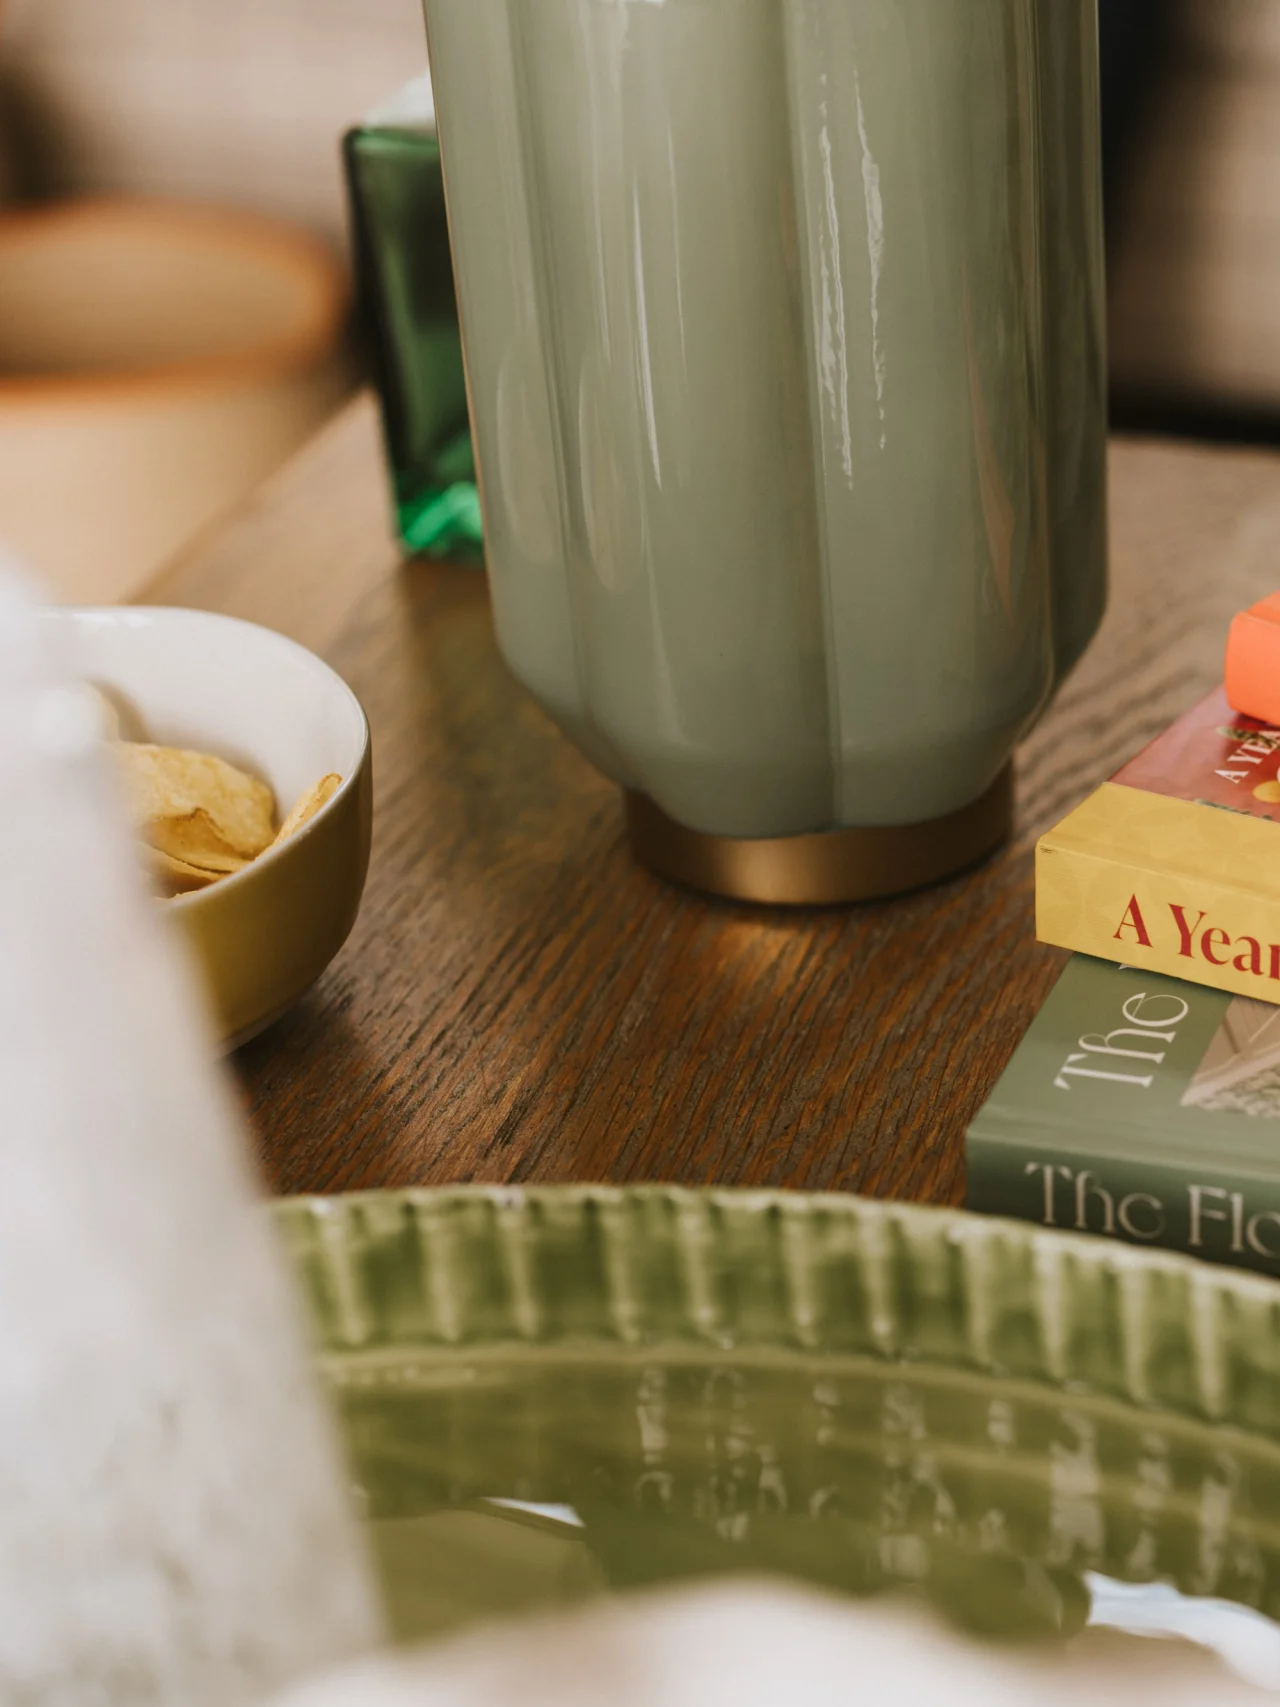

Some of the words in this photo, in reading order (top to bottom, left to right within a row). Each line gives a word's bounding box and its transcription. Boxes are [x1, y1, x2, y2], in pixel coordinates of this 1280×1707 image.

[1214, 769, 1250, 785] A
[1113, 893, 1153, 948] A
[1053, 992, 1189, 1091] The
[1024, 1161, 1165, 1239] The
